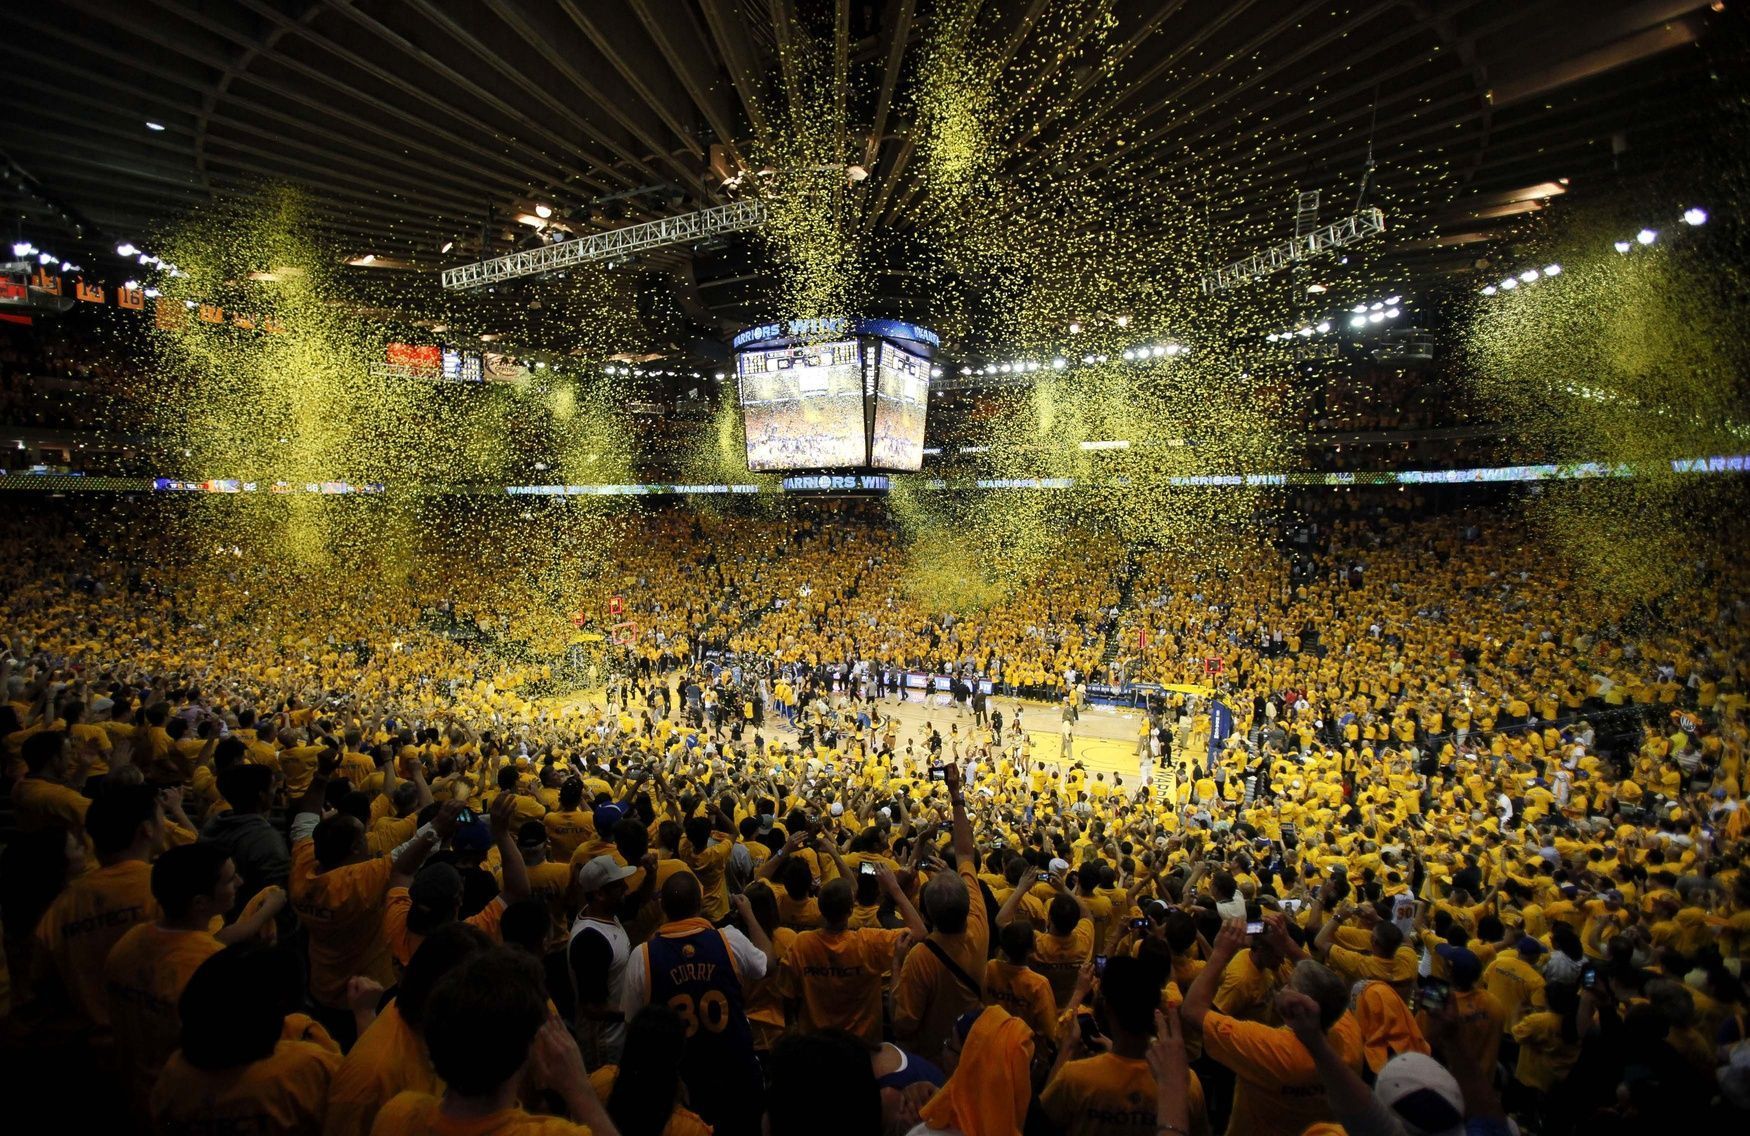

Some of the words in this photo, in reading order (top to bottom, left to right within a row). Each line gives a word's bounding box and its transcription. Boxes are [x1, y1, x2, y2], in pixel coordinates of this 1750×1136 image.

[866, 346, 876, 397] WIRELESS
[674, 484, 728, 493] WARRIORS
[1169, 475, 1242, 485] WARRIORS
[1246, 474, 1287, 485] WIN!
[669, 961, 718, 986] CURRY
